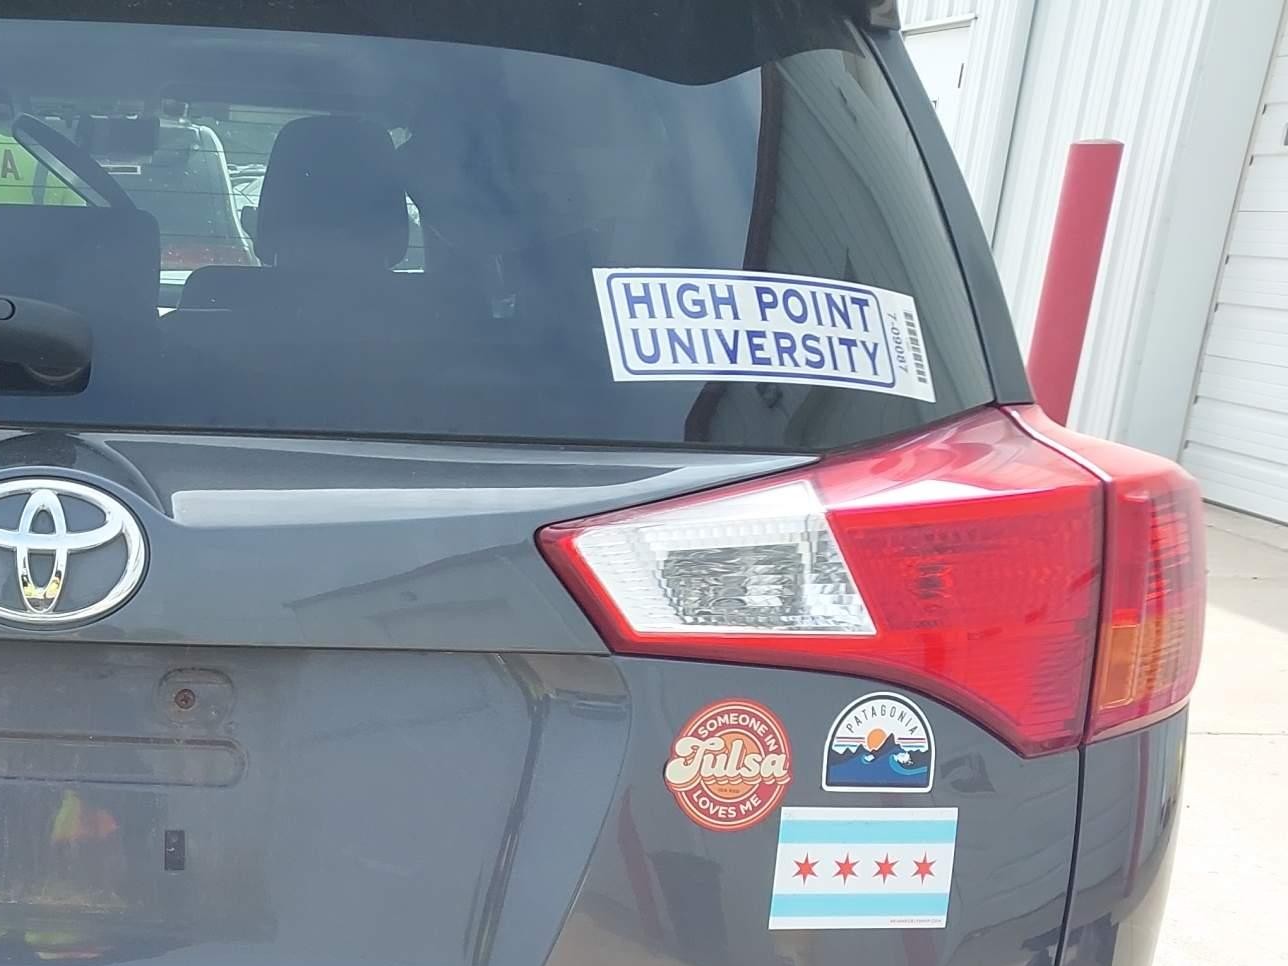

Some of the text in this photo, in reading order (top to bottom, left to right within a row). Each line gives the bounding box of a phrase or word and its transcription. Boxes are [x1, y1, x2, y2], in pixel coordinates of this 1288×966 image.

[623, 283, 873, 332] HIGH POINT
[631, 328, 880, 376] UNIVERSITY
[697, 713, 779, 751] SOMEONE IN
[846, 704, 918, 735] PATAGONIA
[665, 736, 790, 787] Tulsa
[692, 790, 762, 818] LOVES ME
